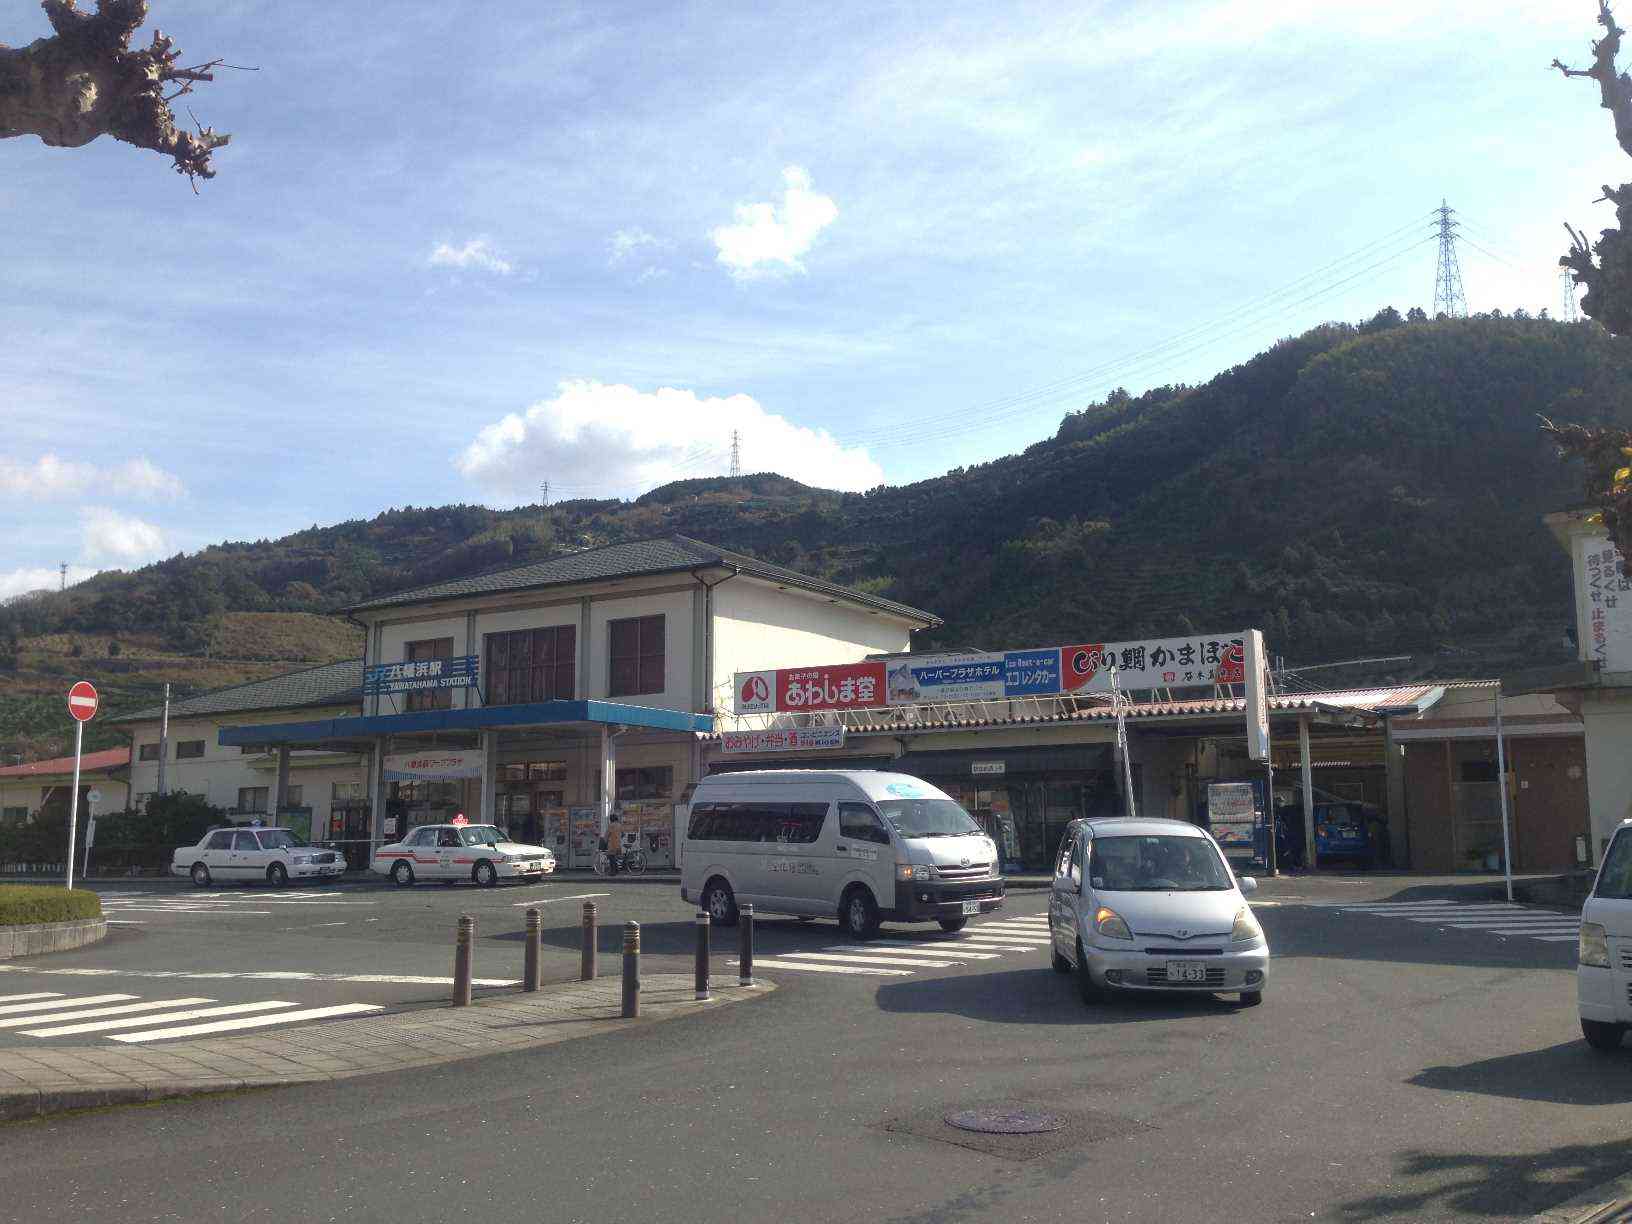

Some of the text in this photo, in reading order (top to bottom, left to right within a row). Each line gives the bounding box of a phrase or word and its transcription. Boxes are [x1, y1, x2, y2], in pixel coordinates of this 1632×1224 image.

[390, 661, 442, 679] 八幡浜駅
[439, 676, 472, 687] STATION
[785, 673, 876, 706] あわしま堂
